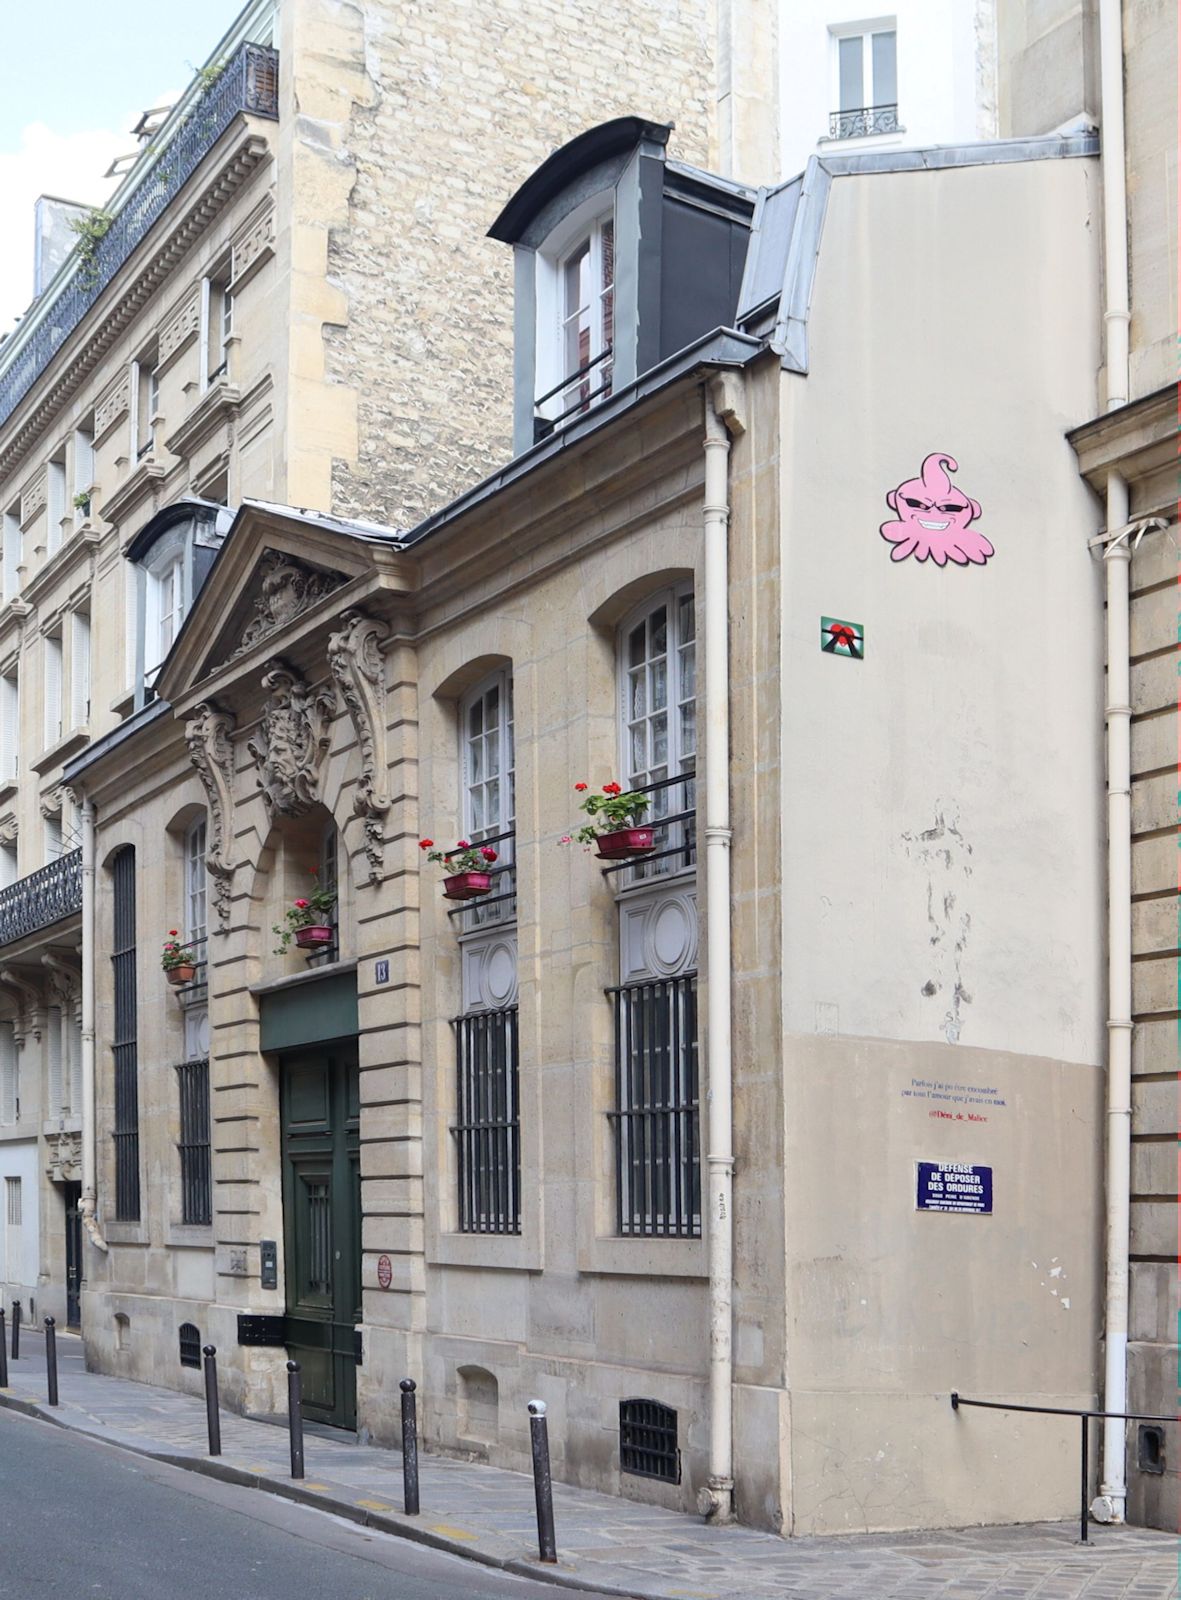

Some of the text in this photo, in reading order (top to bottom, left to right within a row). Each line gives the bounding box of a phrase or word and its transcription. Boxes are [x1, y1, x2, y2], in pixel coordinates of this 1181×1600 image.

[377, 963, 386, 981] 13
[911, 1078, 933, 1088] Parfois
[933, 1081, 944, 1090] j'ai
[901, 1089, 912, 1097] par
[927, 1091, 951, 1100] l'amour
[952, 1095, 963, 1103] que
[964, 1095, 983, 1104] j'avais
[931, 1172, 942, 1181] DE
[928, 1182, 984, 1194] DES ORDURES
